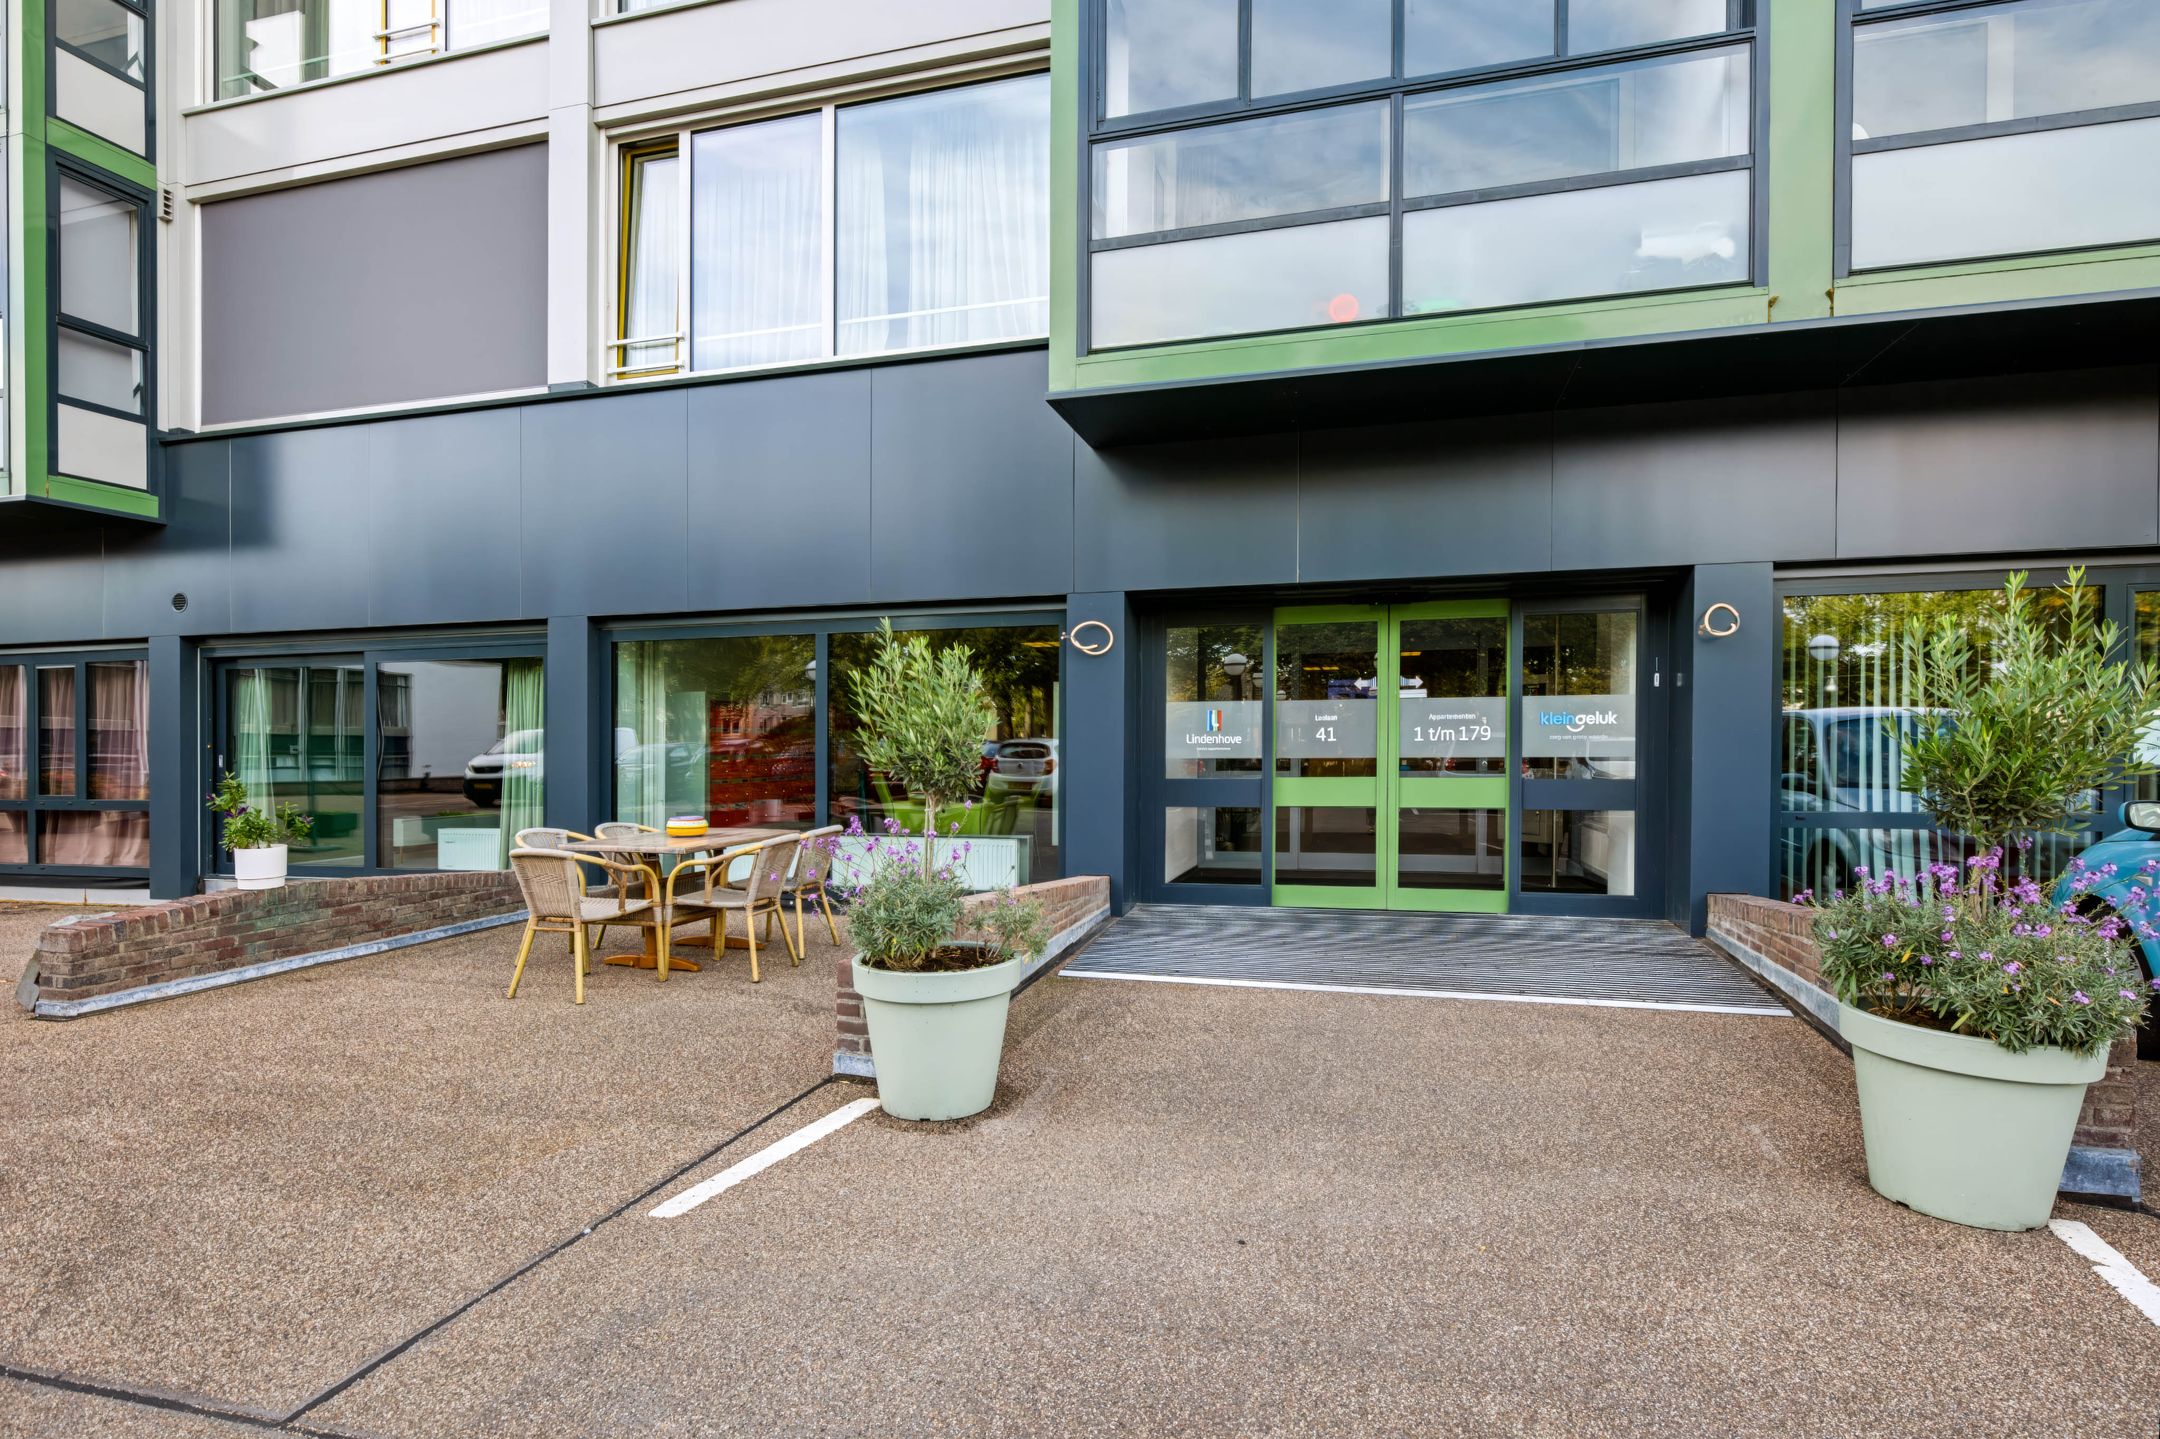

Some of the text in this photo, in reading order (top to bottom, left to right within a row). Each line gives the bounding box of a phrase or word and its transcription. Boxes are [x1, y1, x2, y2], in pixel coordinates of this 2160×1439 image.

[1540, 710, 1618, 733] kleingeluk
[1186, 733, 1242, 744] Lindenhove
[1315, 727, 1337, 742] 41
[1413, 725, 1491, 742] 1 t/m 179
